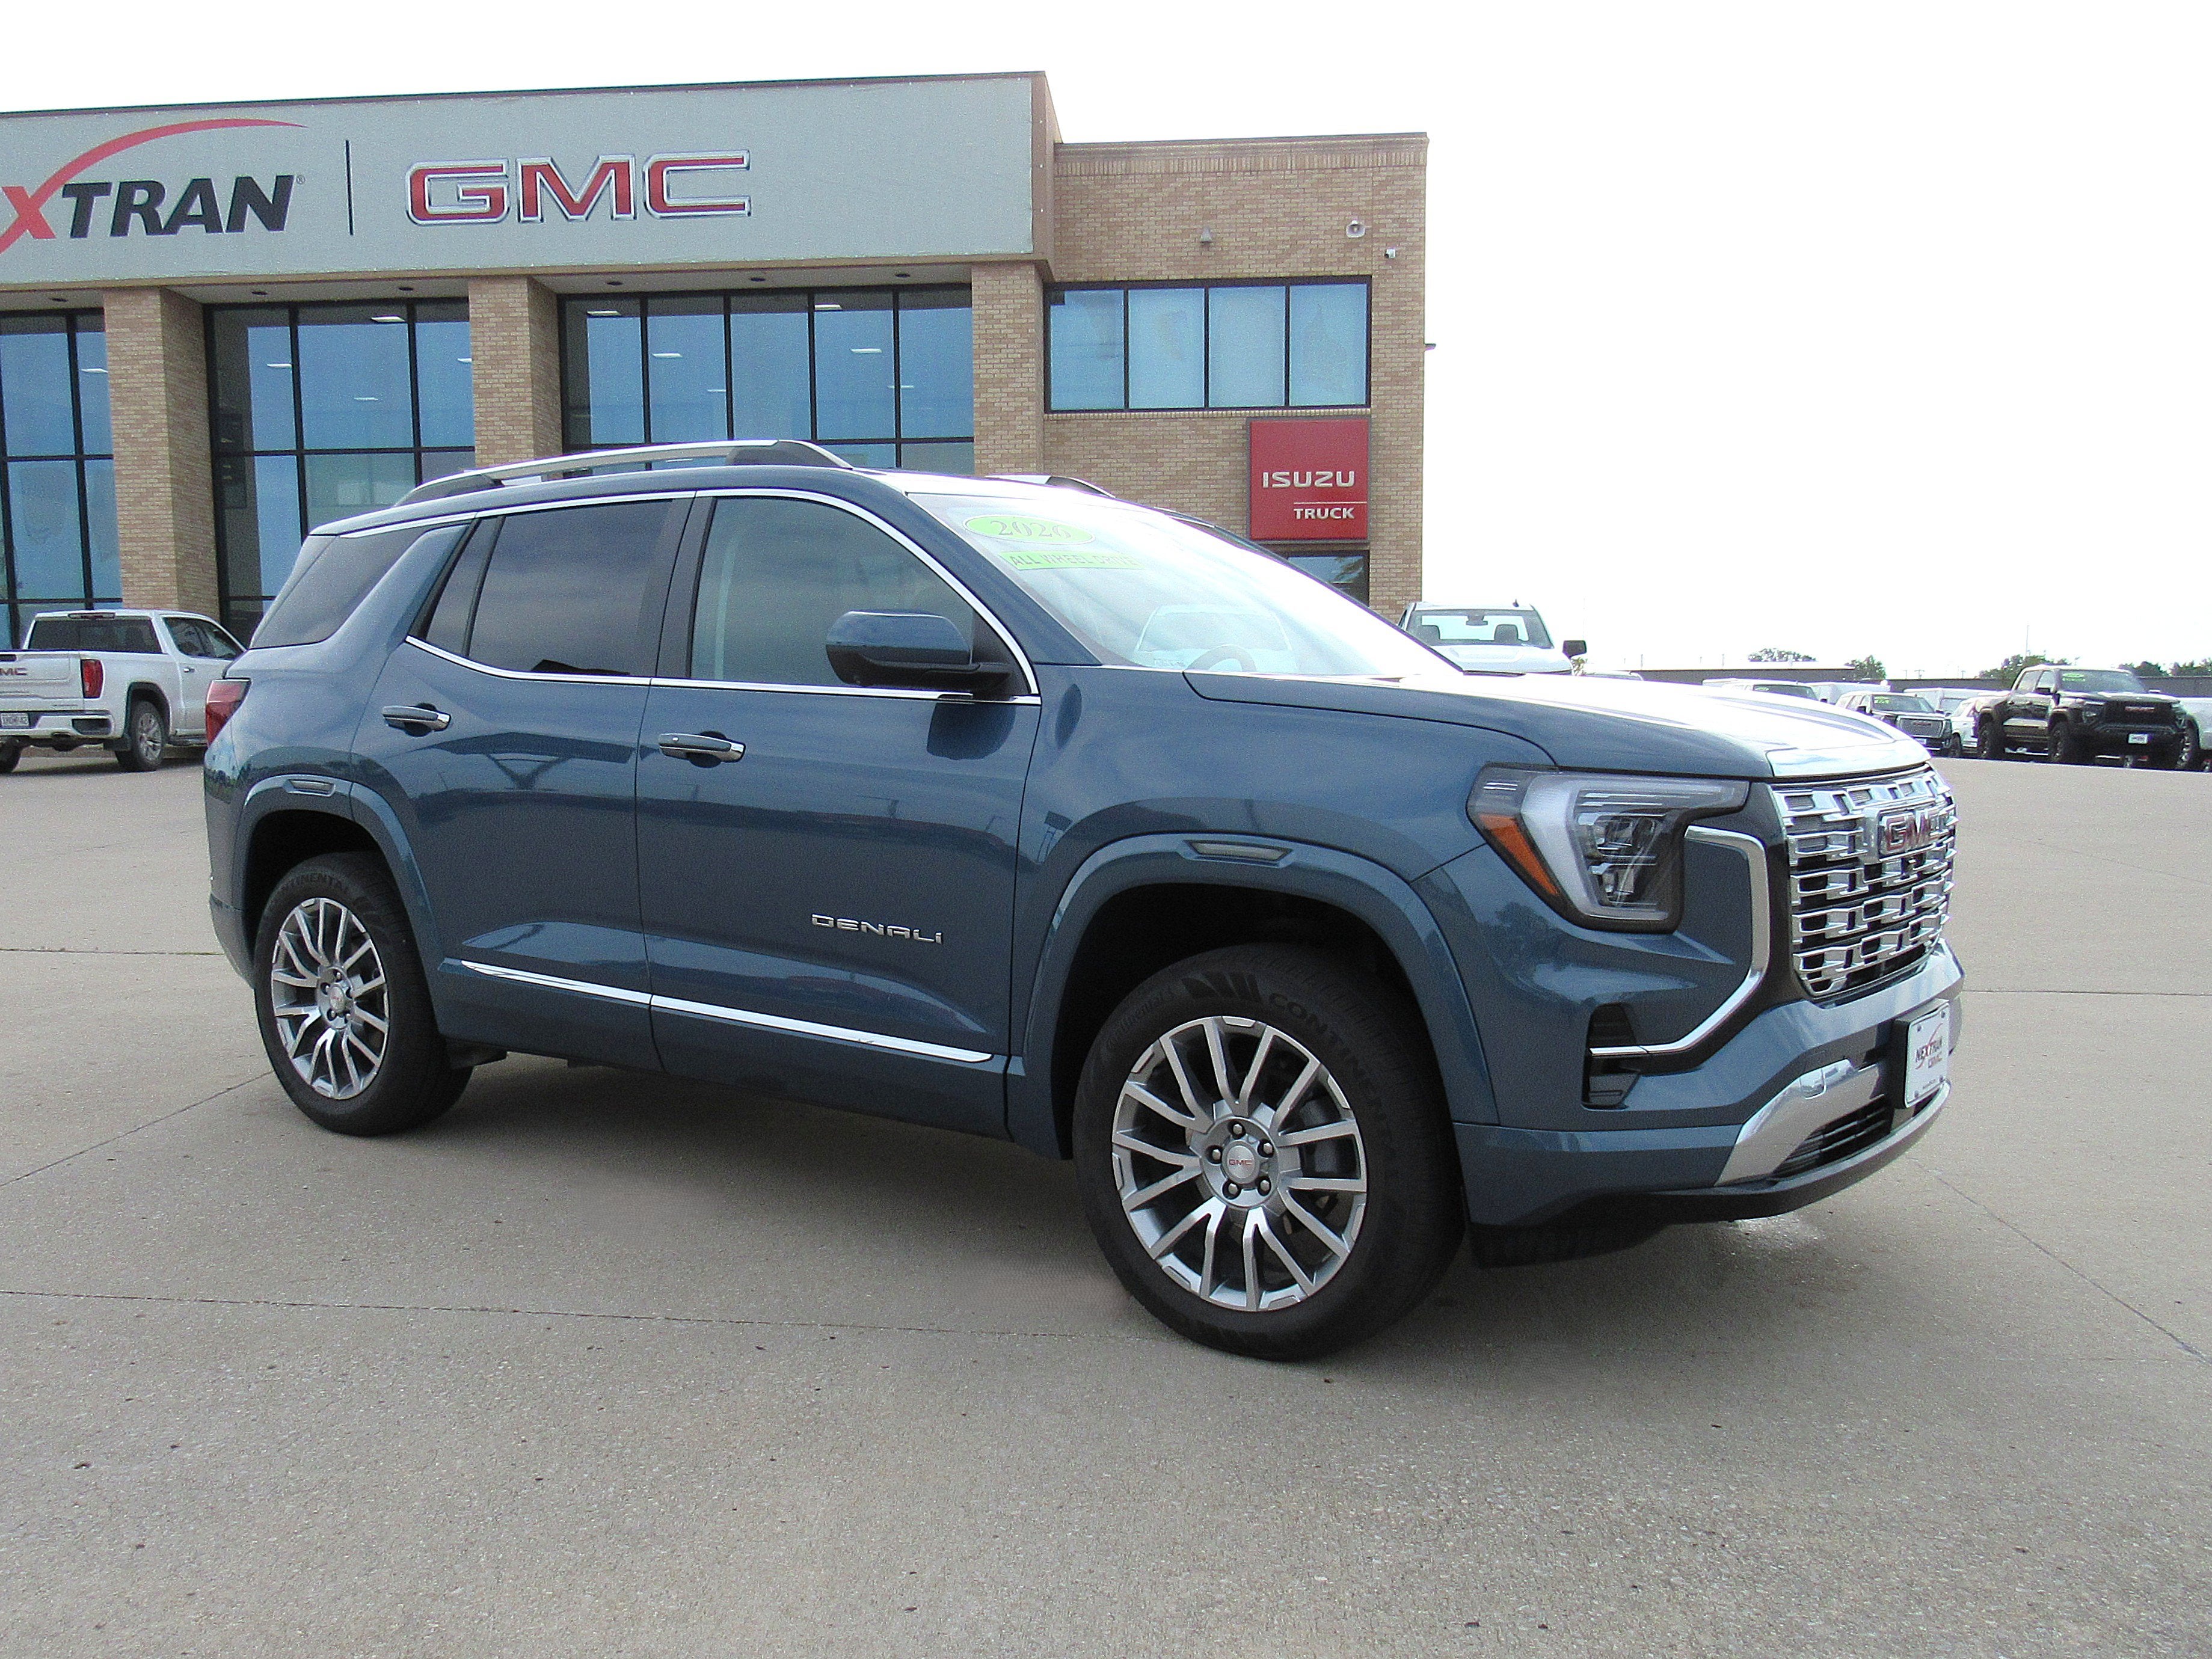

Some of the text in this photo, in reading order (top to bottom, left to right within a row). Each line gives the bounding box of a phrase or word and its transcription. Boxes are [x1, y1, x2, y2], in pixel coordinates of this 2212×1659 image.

[405, 150, 751, 225] GMC
[1262, 470, 1355, 488] ISUZU
[1293, 507, 1354, 520] TRUCK
[1010, 554, 1139, 566] ALL WHEEL DRIVE
[812, 913, 942, 944] DENALI
